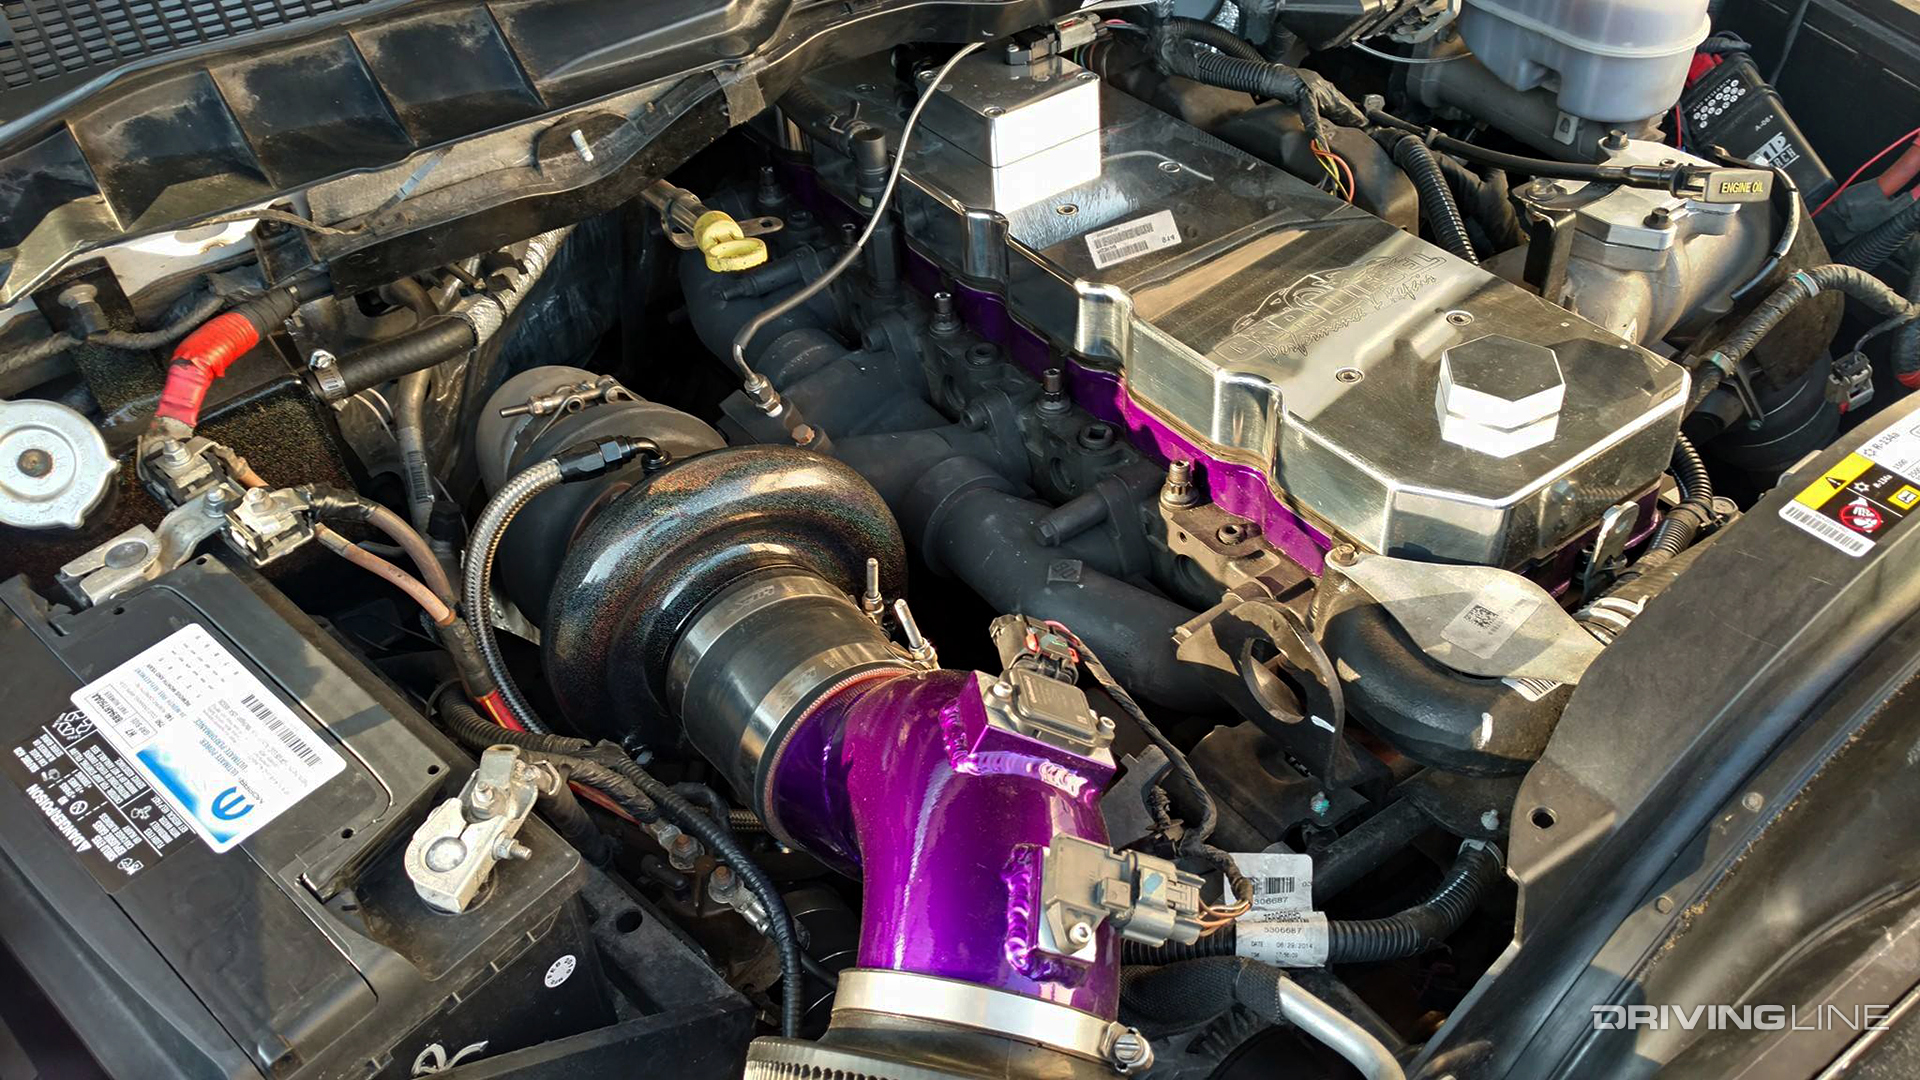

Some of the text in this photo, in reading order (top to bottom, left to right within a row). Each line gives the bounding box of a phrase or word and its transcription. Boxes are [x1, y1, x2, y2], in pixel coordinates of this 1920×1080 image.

[1721, 181, 1763, 193] ENGINE OIL
[193, 716, 228, 749] PERFORMANCE
[213, 753, 239, 776] ULTIMATE
[223, 747, 248, 770] ULTIMATE
[25, 782, 86, 846] DANGER/POISON
